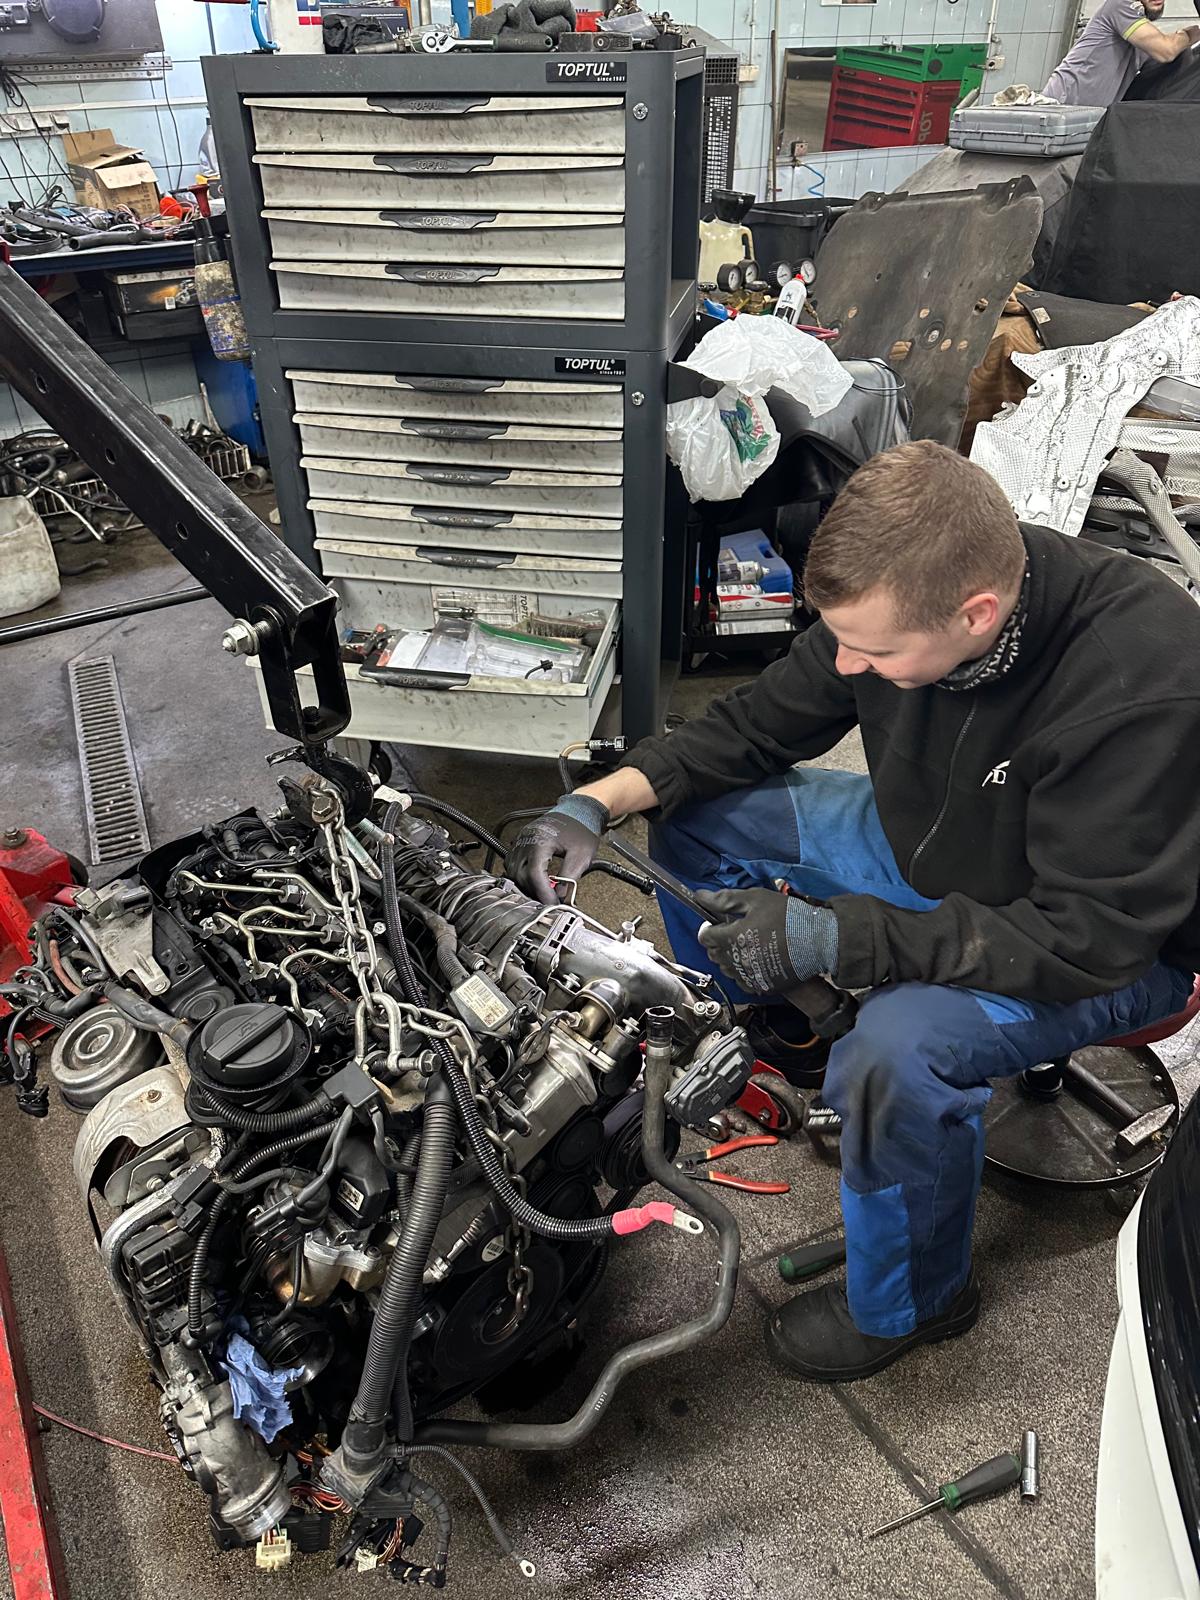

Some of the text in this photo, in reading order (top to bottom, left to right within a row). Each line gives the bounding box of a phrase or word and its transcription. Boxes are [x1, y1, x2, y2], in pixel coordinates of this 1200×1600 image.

[557, 63, 611, 76] TOPTUL
[415, 161, 449, 170] TOPTUL
[422, 216, 453, 226] TOPTUL
[565, 358, 612, 371] TOPTUL
[520, 595, 529, 619] TOPTU
